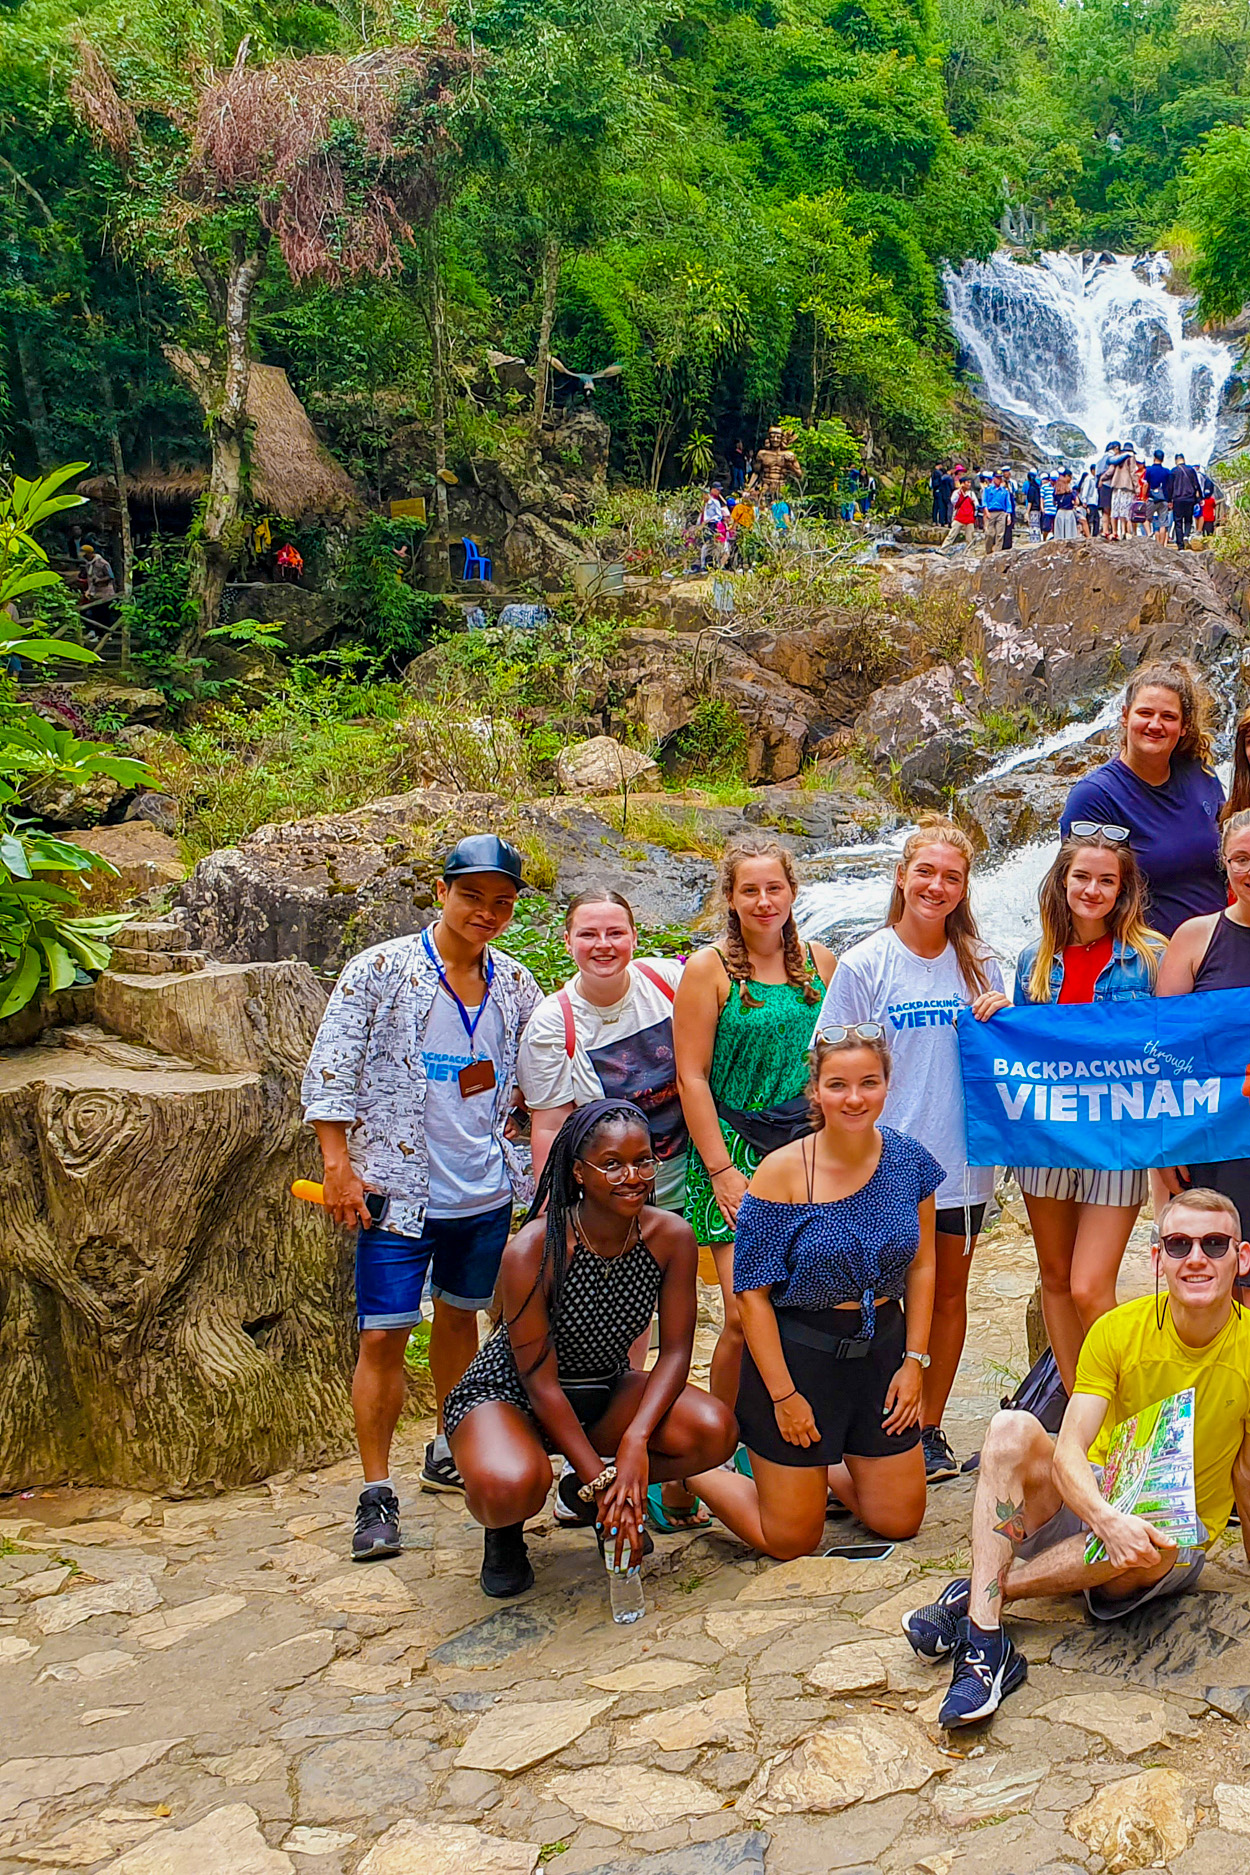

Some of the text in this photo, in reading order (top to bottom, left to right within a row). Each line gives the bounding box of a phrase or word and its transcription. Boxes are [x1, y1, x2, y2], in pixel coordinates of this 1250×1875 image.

[887, 999, 960, 1014] BACKPACKING
[993, 1040, 1194, 1081] BACKPACKING through
[995, 1077, 1221, 1122] VIETNAM
